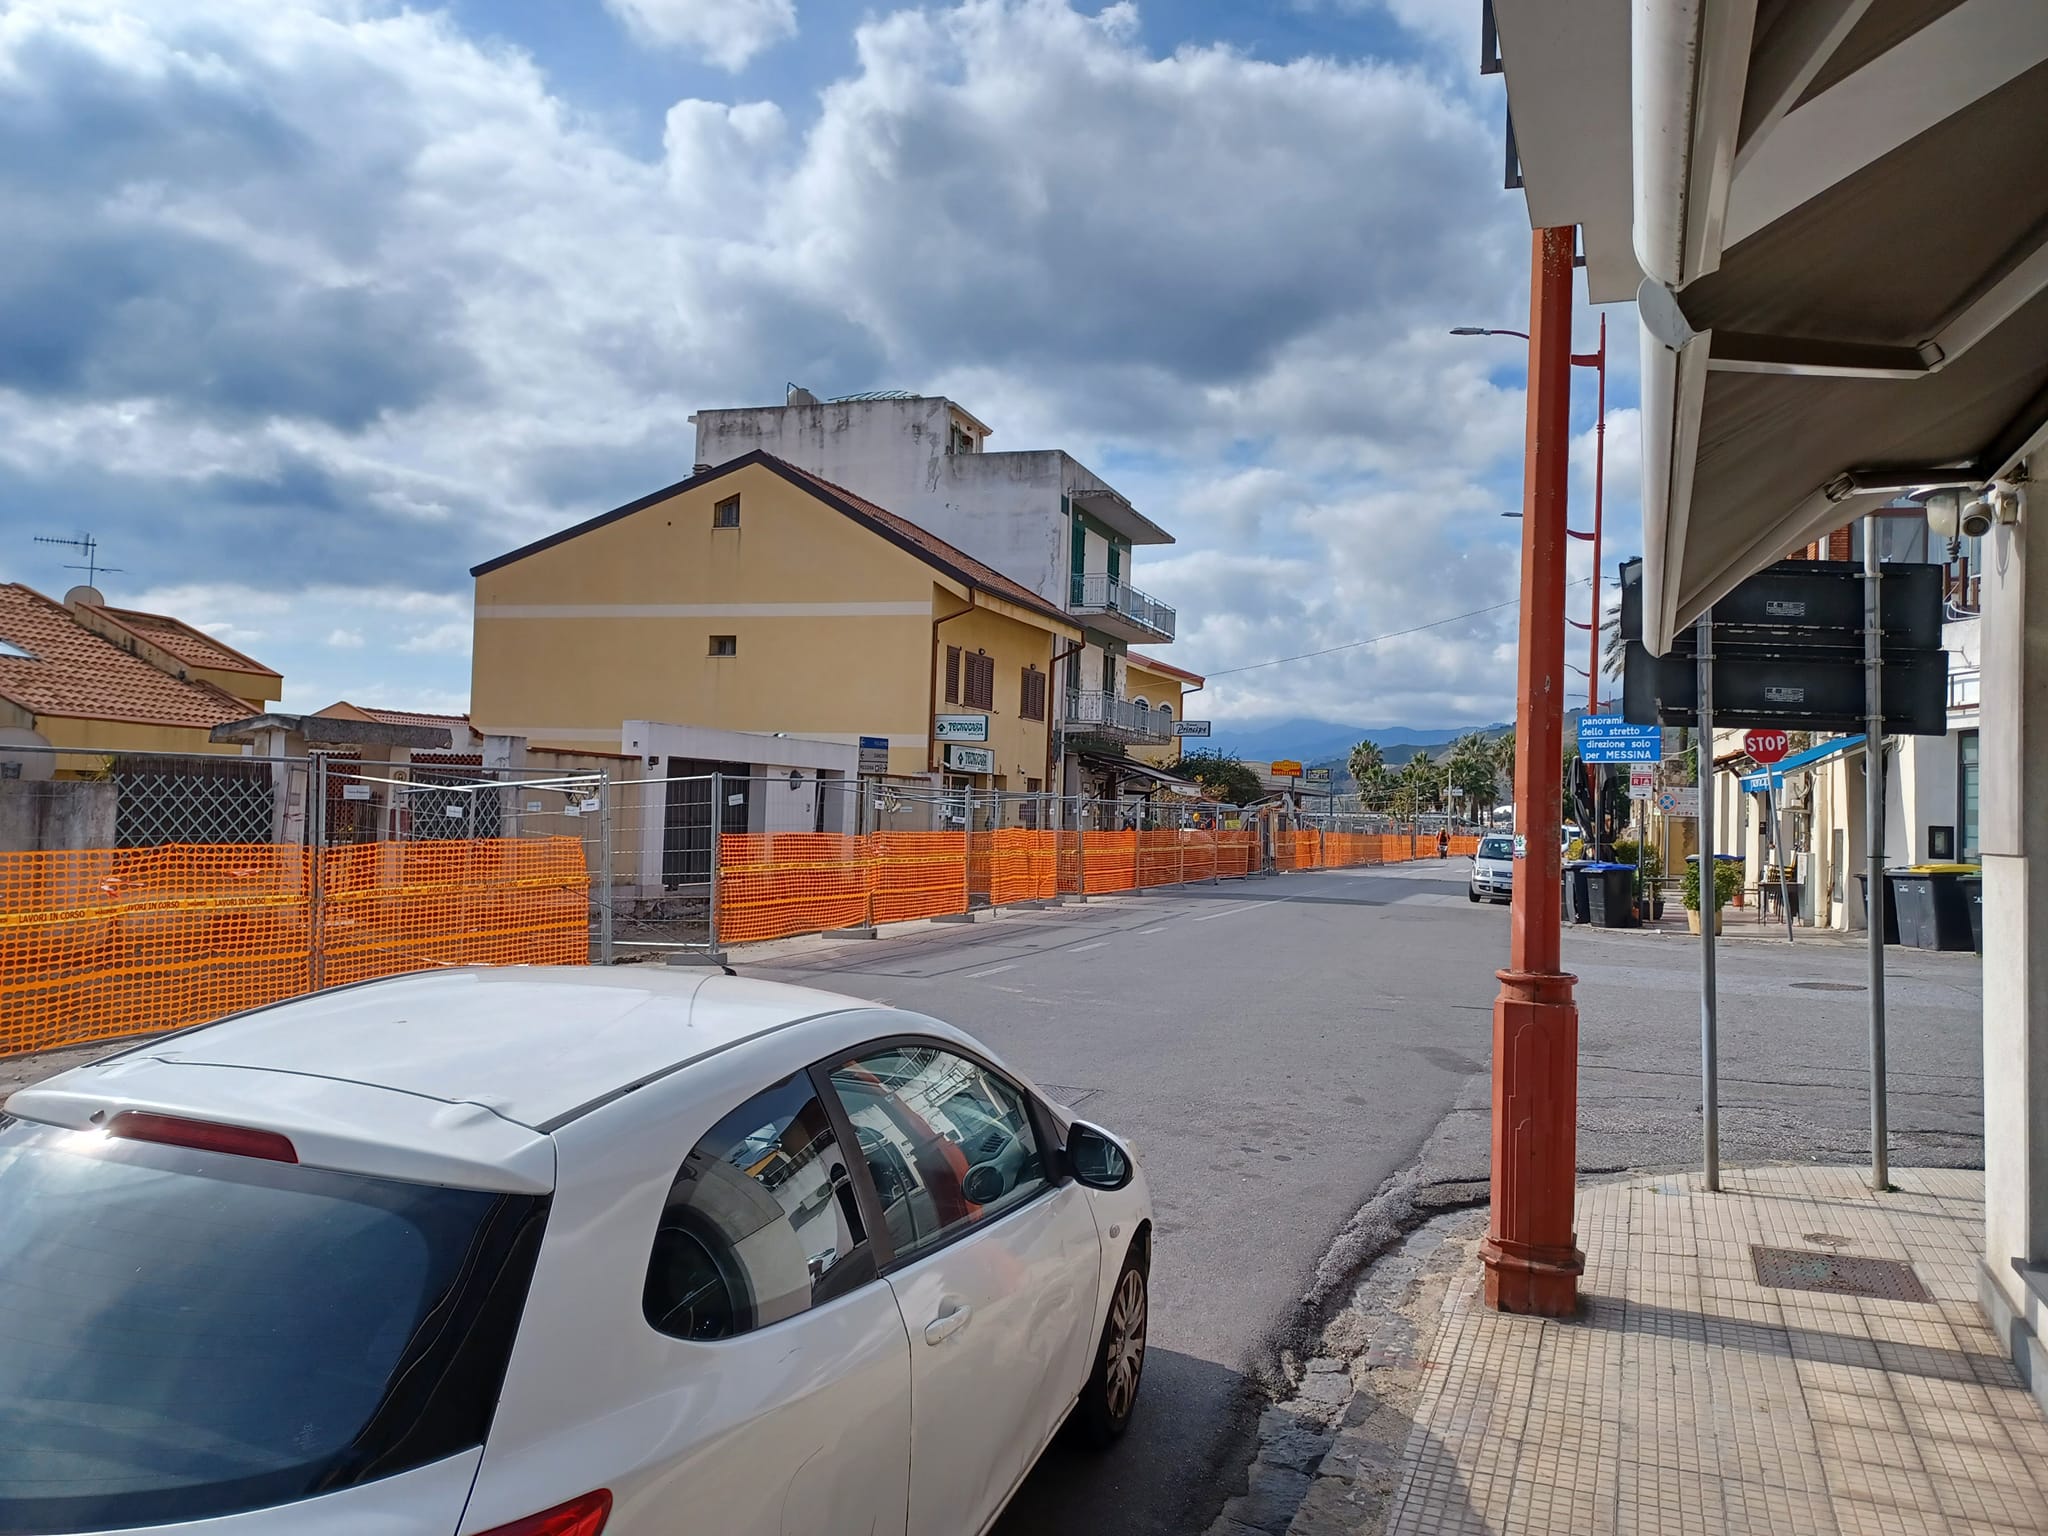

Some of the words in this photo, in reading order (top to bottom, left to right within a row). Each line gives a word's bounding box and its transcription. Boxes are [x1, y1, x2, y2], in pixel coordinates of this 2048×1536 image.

[1582, 716, 1624, 727] panorami
[948, 722, 983, 732] TECNOCASA
[1581, 727, 1604, 736] dello
[1609, 727, 1640, 736] stretto
[1586, 740, 1626, 749] direzione
[1631, 739, 1651, 748] solo
[1746, 735, 1786, 752] STOP
[1585, 752, 1600, 761] per
[1606, 750, 1651, 759] MESSINA
[148, 902, 157, 910] IN
[158, 901, 180, 909] CORSO
[18, 913, 47, 923] LAVORI
[49, 912, 58, 920] IN
[60, 910, 86, 920] CORSO
